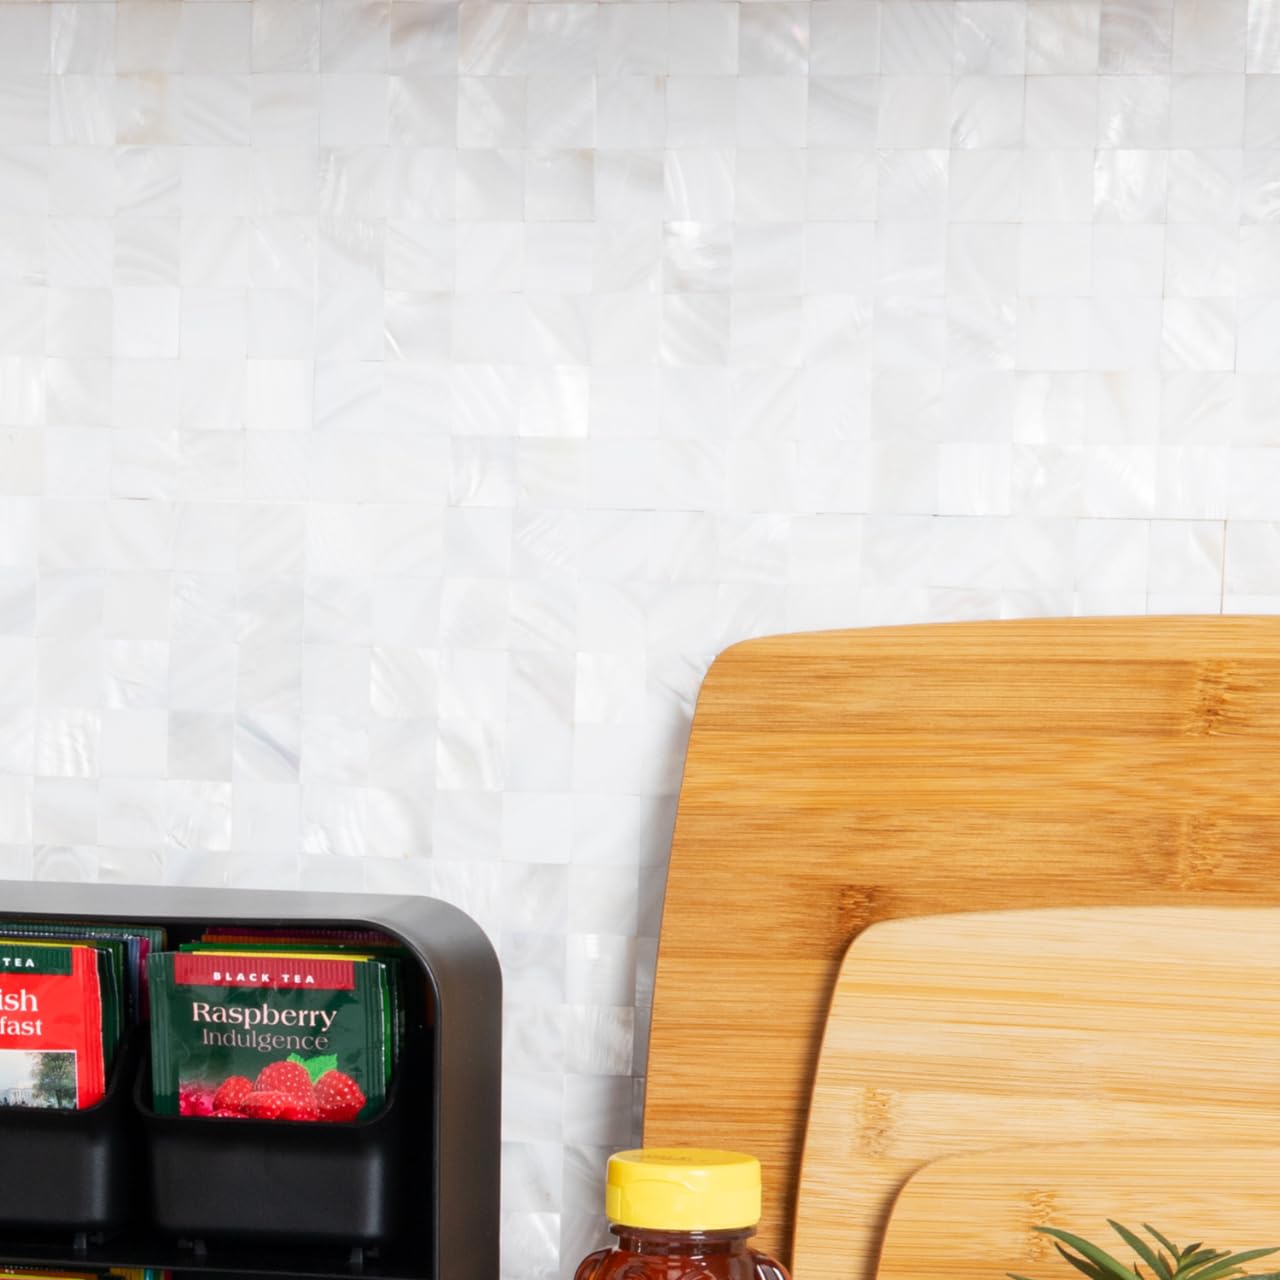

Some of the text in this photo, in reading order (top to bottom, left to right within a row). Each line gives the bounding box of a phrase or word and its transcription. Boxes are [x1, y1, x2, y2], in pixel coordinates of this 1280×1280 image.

[3, 957, 35, 968] TEA
[213, 972, 315, 984] BLACK TEA
[192, 1002, 337, 1032] Raspberry
[202, 1028, 328, 1052] Indulgence
